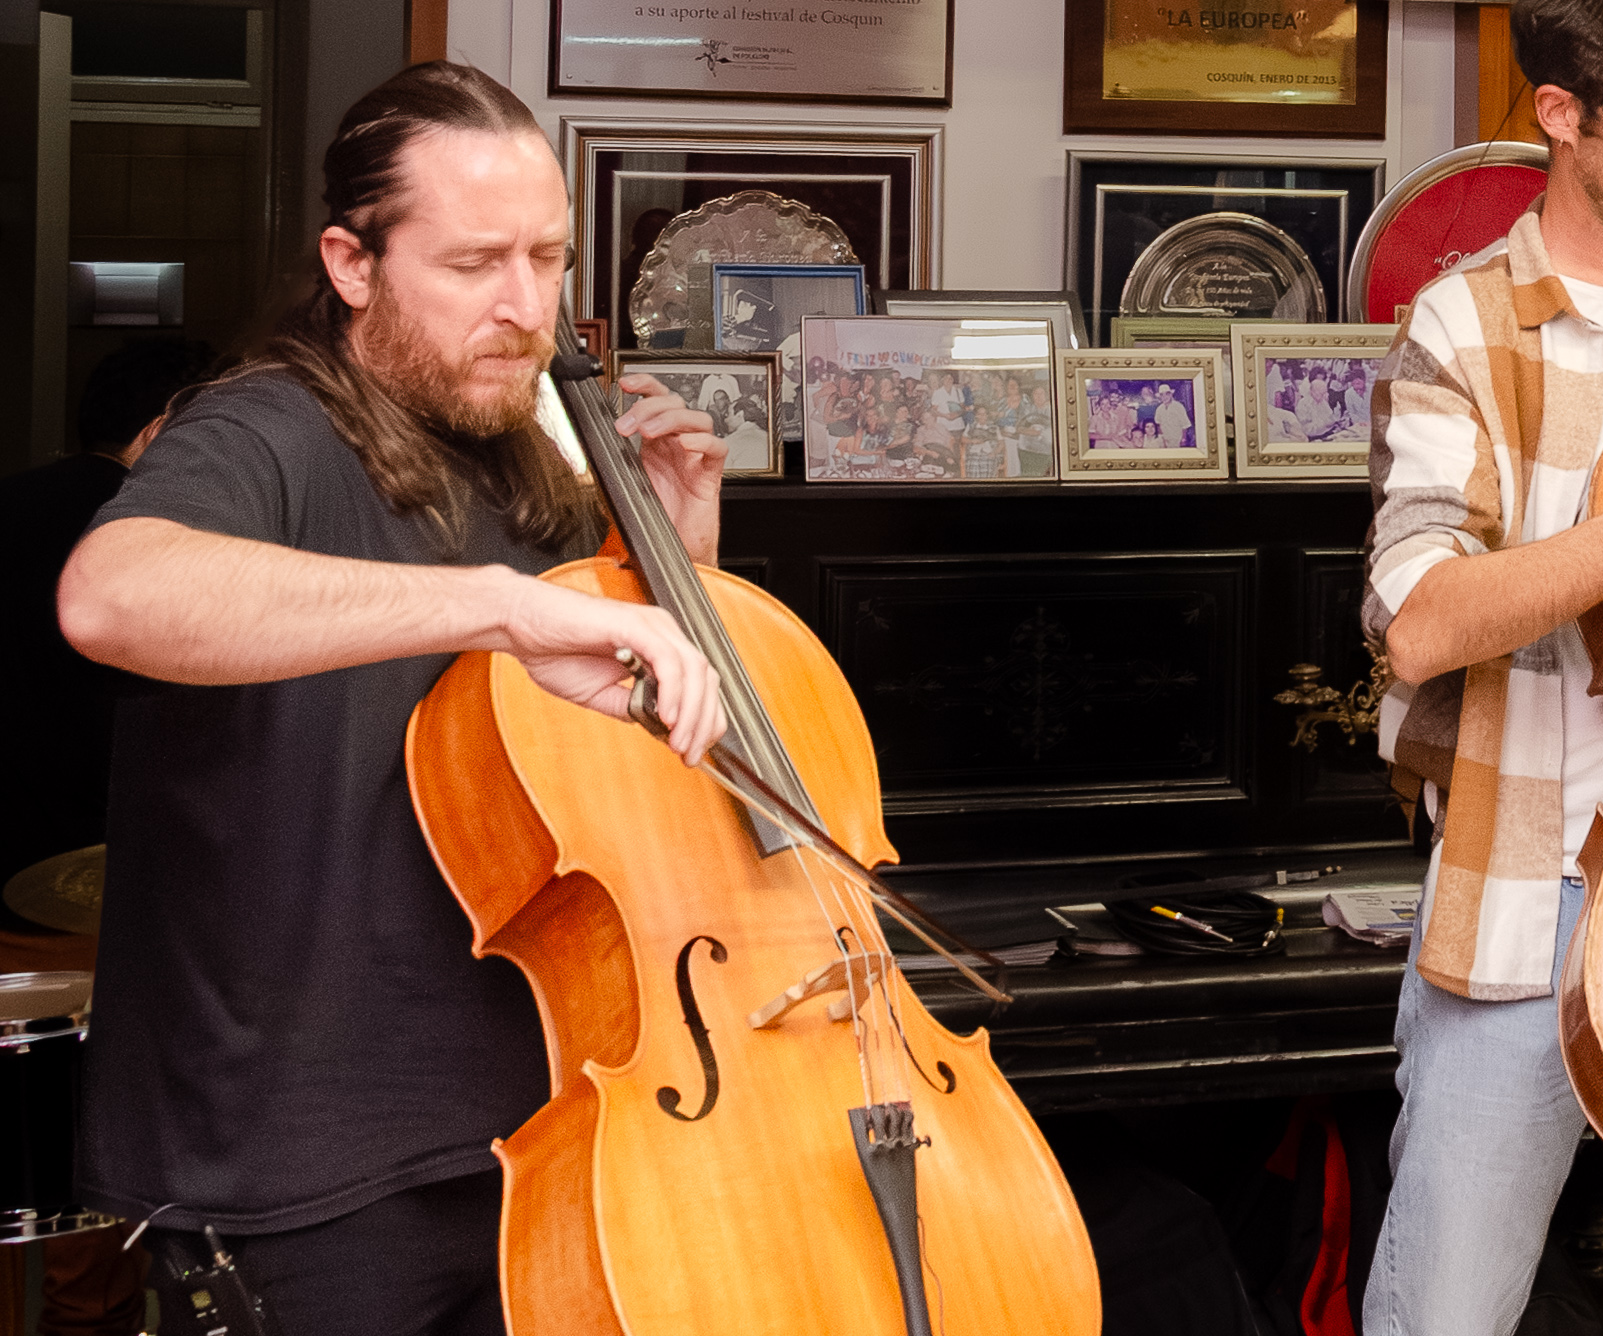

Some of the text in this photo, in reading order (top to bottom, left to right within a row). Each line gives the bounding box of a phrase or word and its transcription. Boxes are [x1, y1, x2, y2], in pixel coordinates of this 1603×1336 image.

[635, 6, 643, 17] a
[647, 6, 665, 18] su
[670, 5, 719, 22] aporte
[722, 5, 737, 20] al
[741, 7, 794, 22] festival
[799, 9, 817, 24] de
[1260, 73, 1293, 84] ENERO
[1297, 75, 1309, 85] DE
